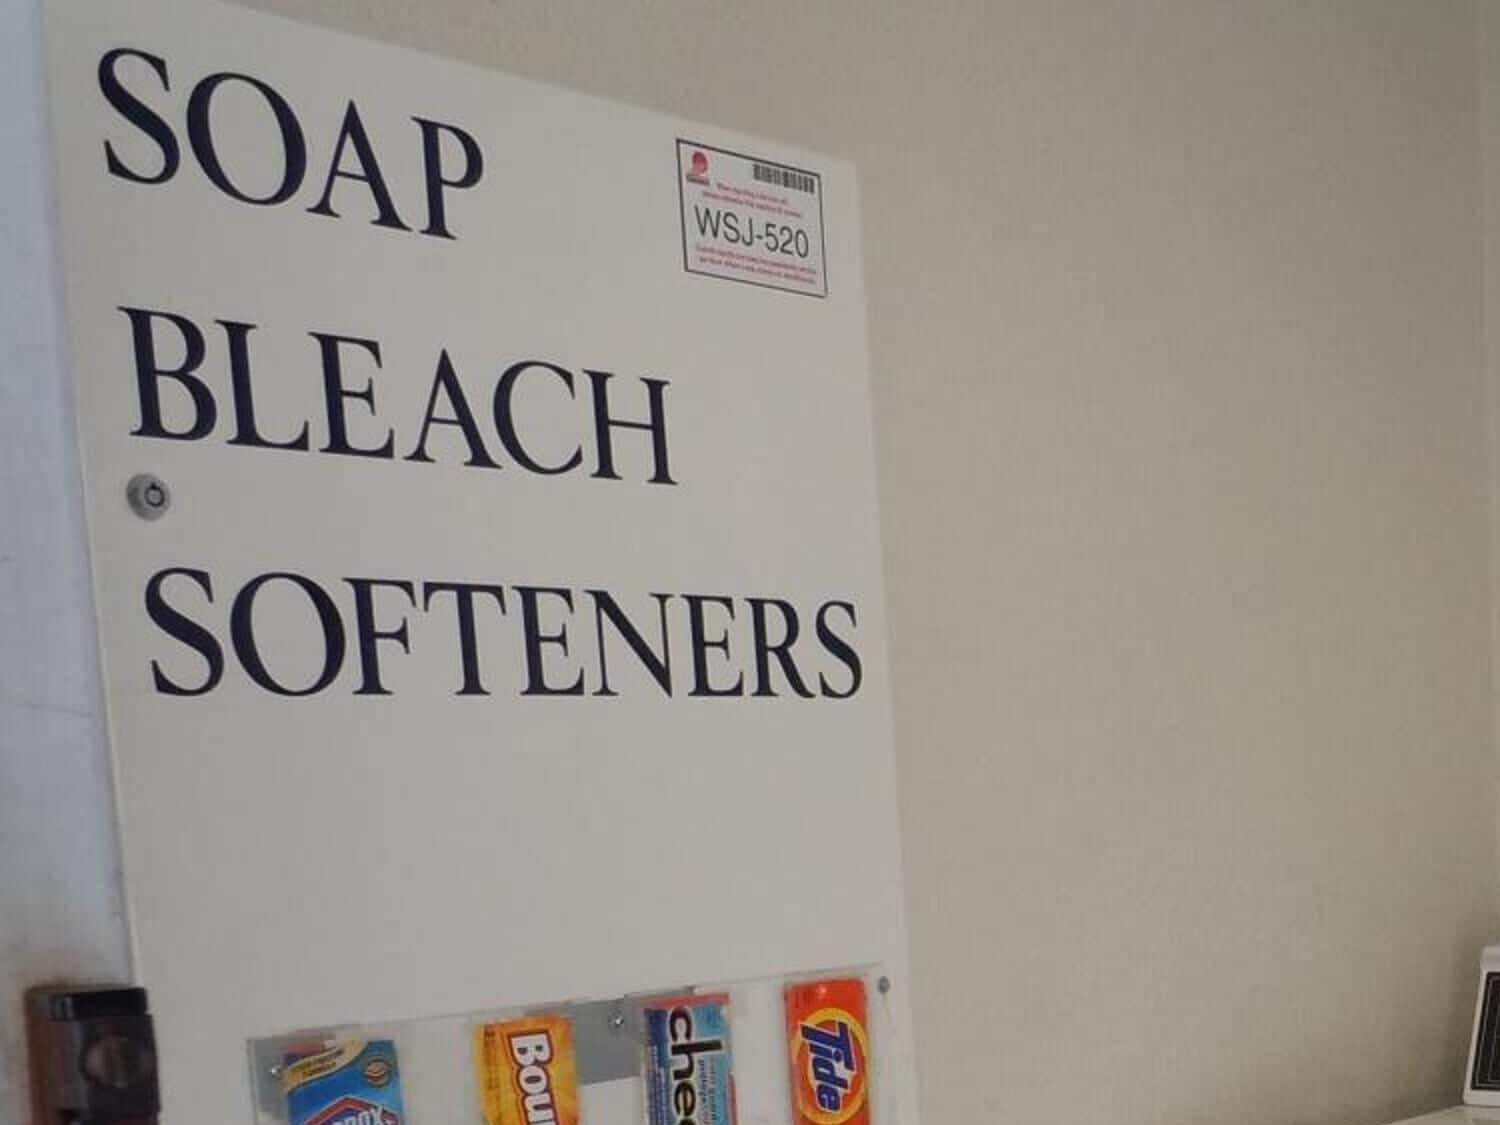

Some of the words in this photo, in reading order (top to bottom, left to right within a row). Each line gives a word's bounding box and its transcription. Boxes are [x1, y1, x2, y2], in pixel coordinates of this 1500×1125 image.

[97, 47, 484, 241] SOAP
[694, 204, 809, 258] WSJ-520
[117, 304, 679, 486] BLEACH
[143, 566, 864, 701] SOFTENERS
[800, 1020, 857, 1113] Tide
